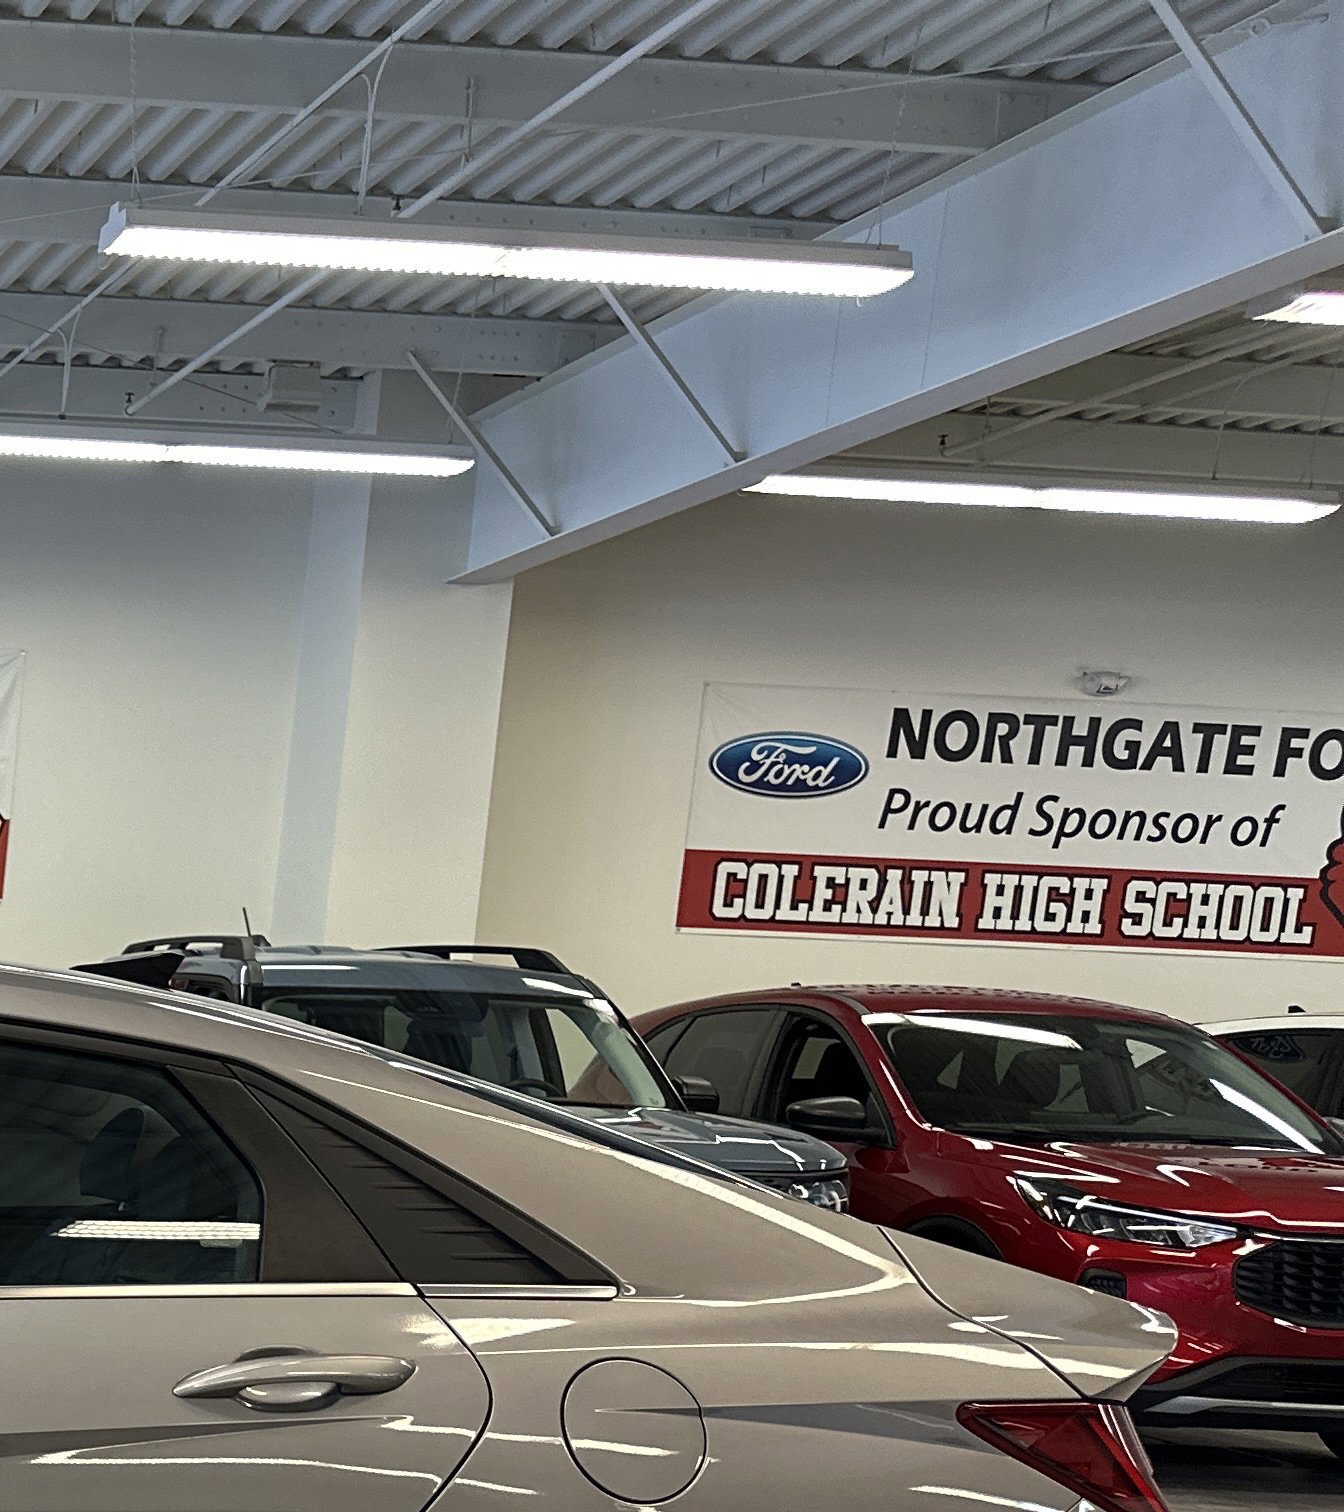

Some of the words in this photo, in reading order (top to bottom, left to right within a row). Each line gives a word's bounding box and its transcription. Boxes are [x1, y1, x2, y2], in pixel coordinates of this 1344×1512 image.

[738, 741, 841, 787] Ford
[885, 707, 1263, 776] NORTHGATE
[877, 787, 1024, 837] Proud
[1027, 794, 1224, 849] Sponsor
[1230, 803, 1287, 848] of
[712, 861, 966, 929] COLERAIN
[977, 873, 1109, 935] HIGH
[1120, 880, 1313, 945] SCHOOL
